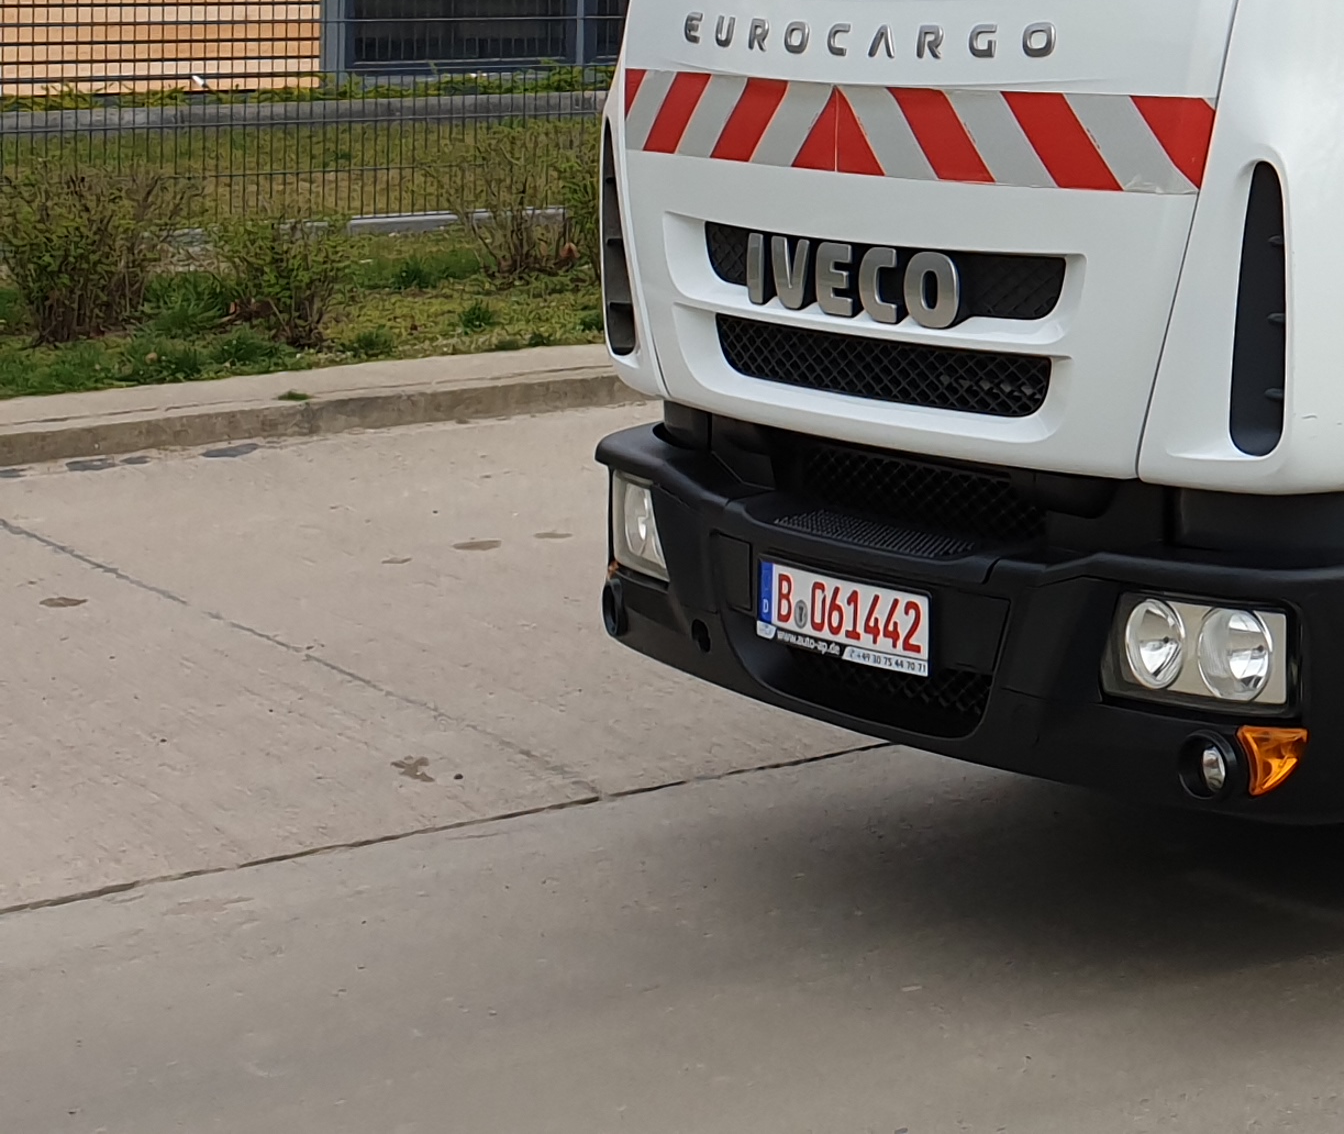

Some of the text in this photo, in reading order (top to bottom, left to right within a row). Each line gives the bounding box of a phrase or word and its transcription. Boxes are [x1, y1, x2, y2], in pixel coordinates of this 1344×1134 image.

[684, 11, 1057, 59] EUROCARGO
[746, 232, 961, 329] IVECO
[762, 598, 769, 614] D
[777, 573, 922, 654] B 061442
[776, 629, 841, 655] www.auto-ap.de
[883, 656, 893, 667] 75
[906, 660, 916, 671] 70
